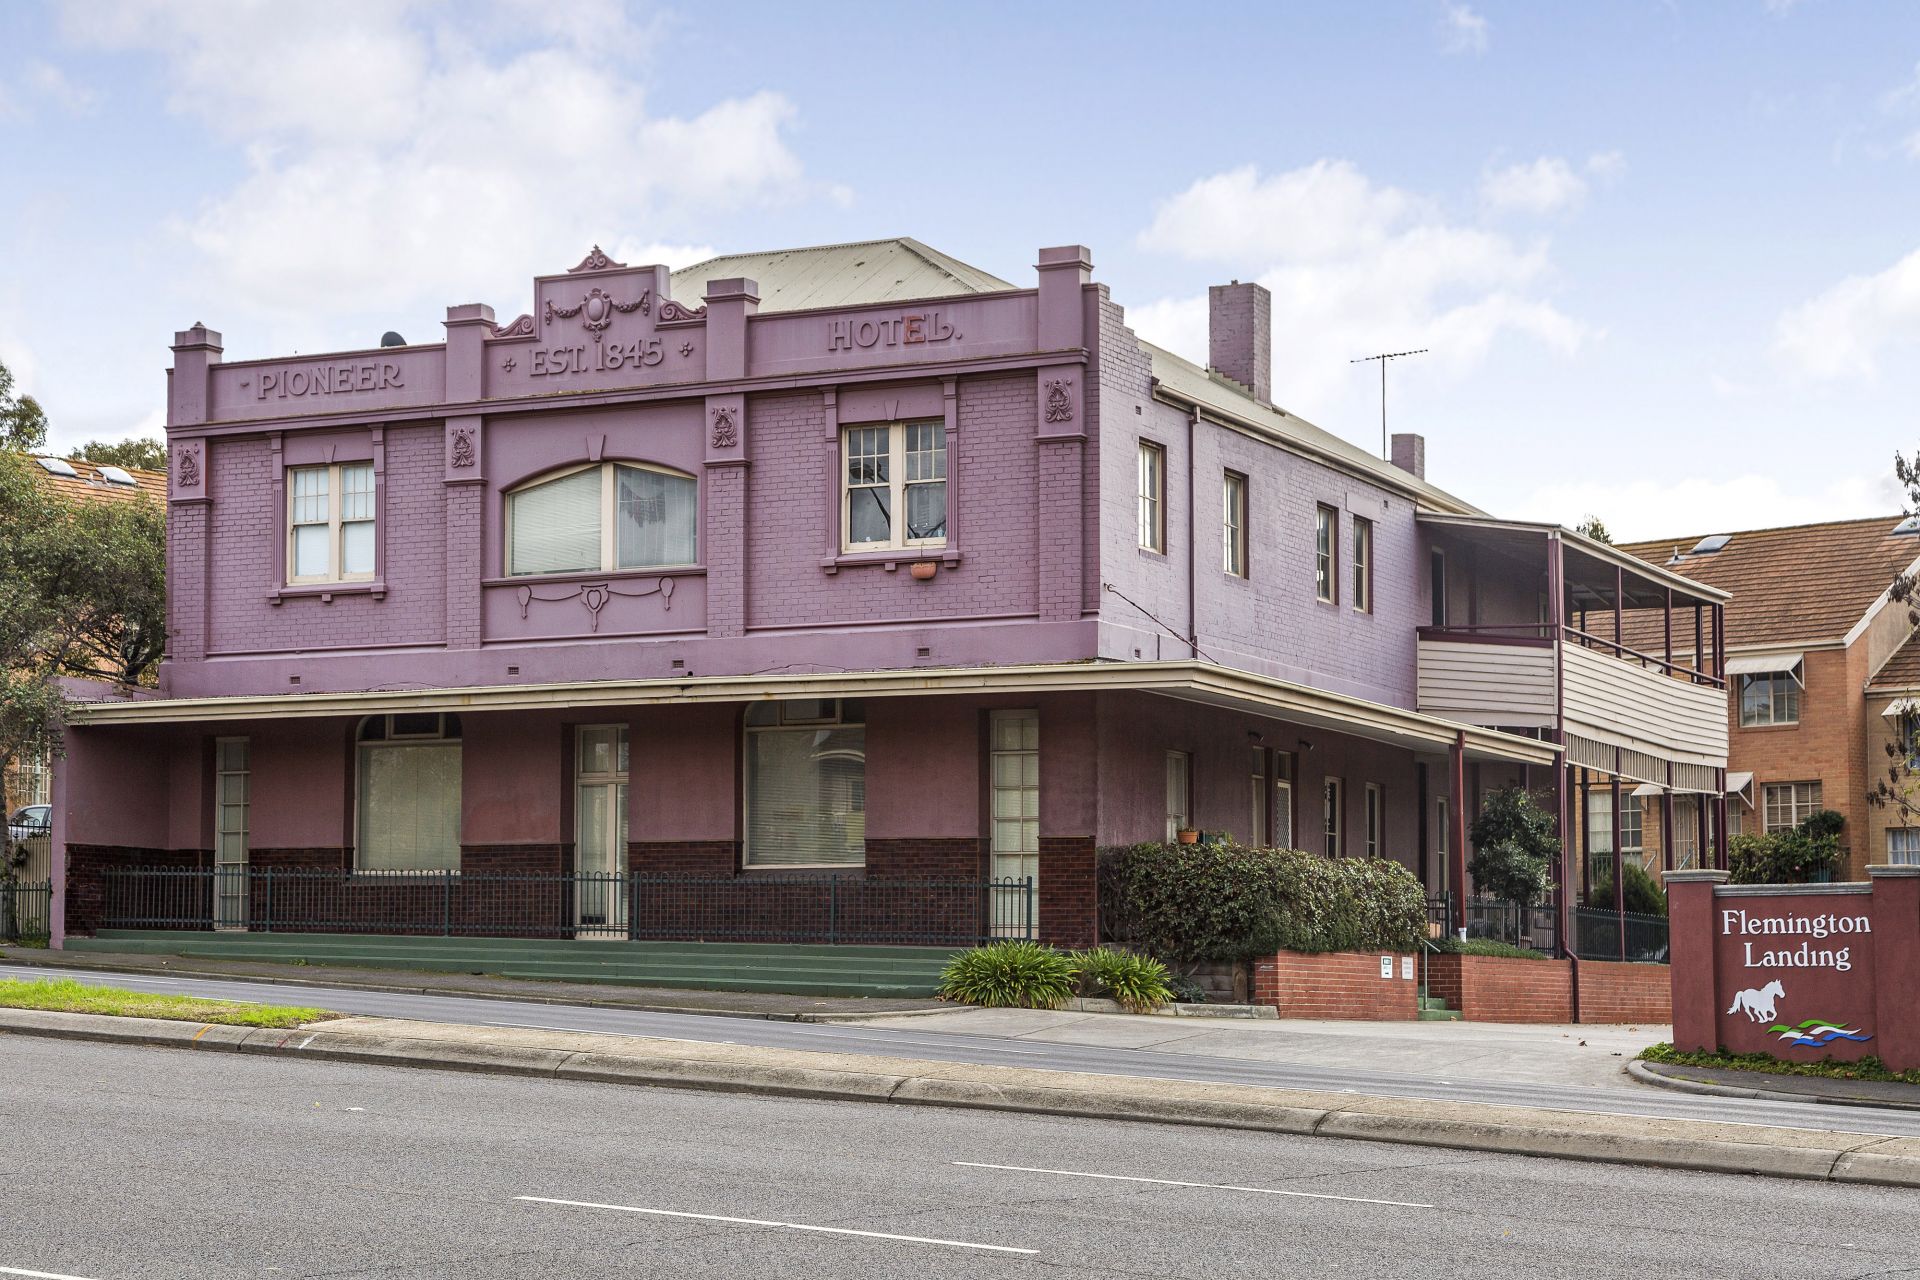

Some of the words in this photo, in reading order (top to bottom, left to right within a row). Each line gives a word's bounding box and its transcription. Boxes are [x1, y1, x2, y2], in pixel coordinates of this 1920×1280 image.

[530, 345, 588, 376] EST.
[595, 338, 664, 372] 1845
[257, 362, 405, 400] PIONEER
[1721, 909, 1872, 939] Flemington
[1743, 941, 1852, 972] Landing
